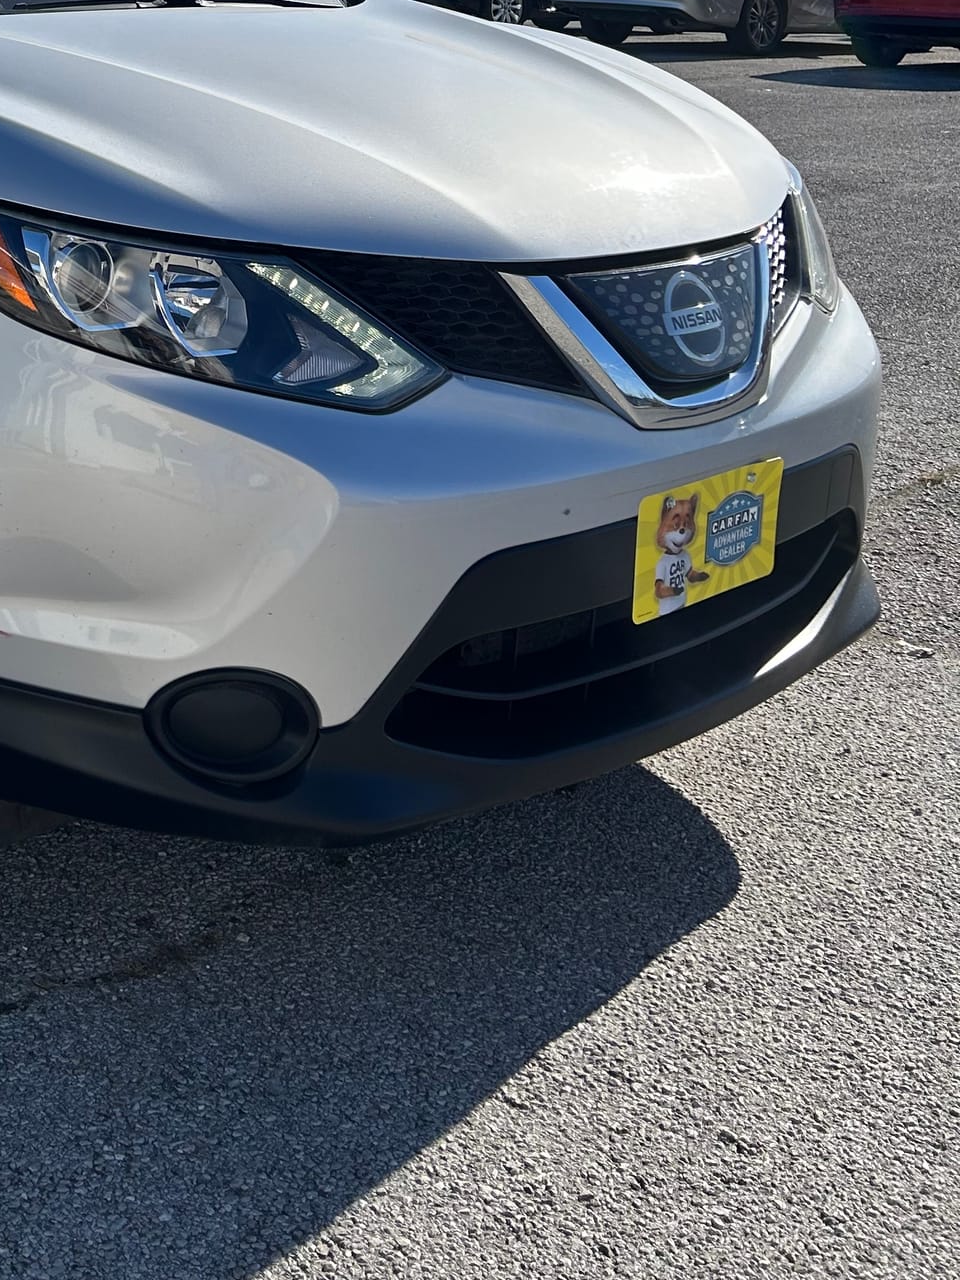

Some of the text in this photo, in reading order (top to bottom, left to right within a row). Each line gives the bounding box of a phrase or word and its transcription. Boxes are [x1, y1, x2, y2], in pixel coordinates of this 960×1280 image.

[671, 308, 722, 330] NISSAN
[711, 508, 758, 534] CARFAX
[713, 526, 753, 549] ADVANTAGE
[719, 541, 746, 560] DEALER
[669, 559, 686, 576] CAR
[669, 572, 685, 588] FOX
